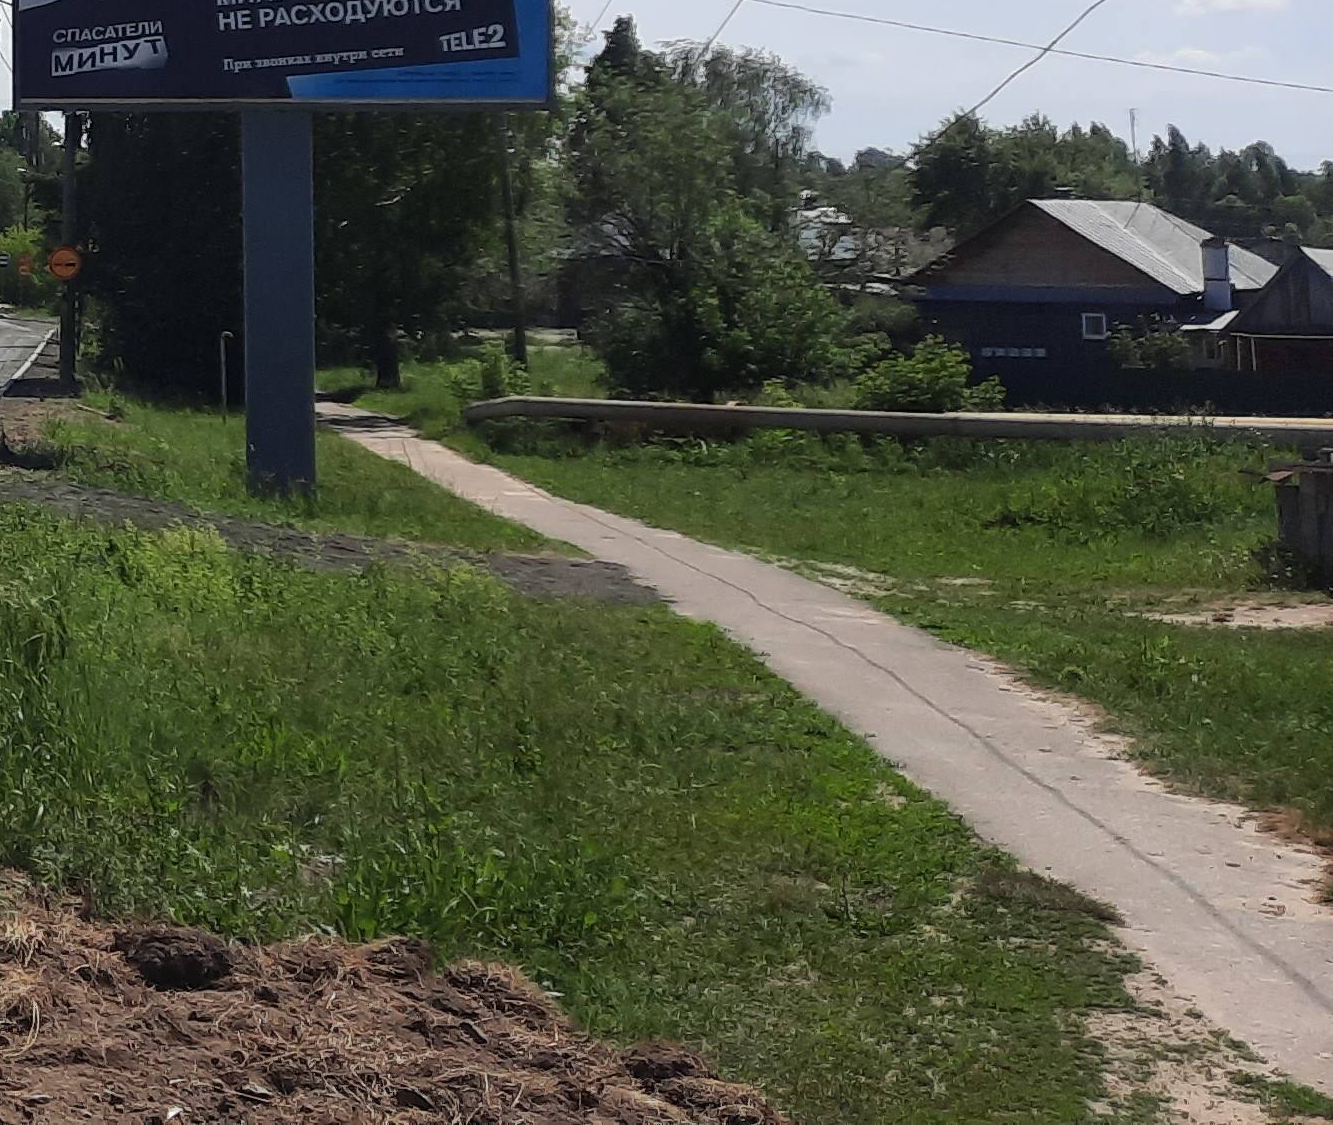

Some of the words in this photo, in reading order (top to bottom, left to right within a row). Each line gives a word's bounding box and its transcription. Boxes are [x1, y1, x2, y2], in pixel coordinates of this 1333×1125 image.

[53, 20, 163, 43] СПАСАТЕЛИ
[218, 9, 253, 32] НЕ
[439, 24, 506, 52] TELE2
[54, 38, 162, 73] МИНУТ
[223, 58, 251, 72] При
[371, 46, 405, 58] сети
